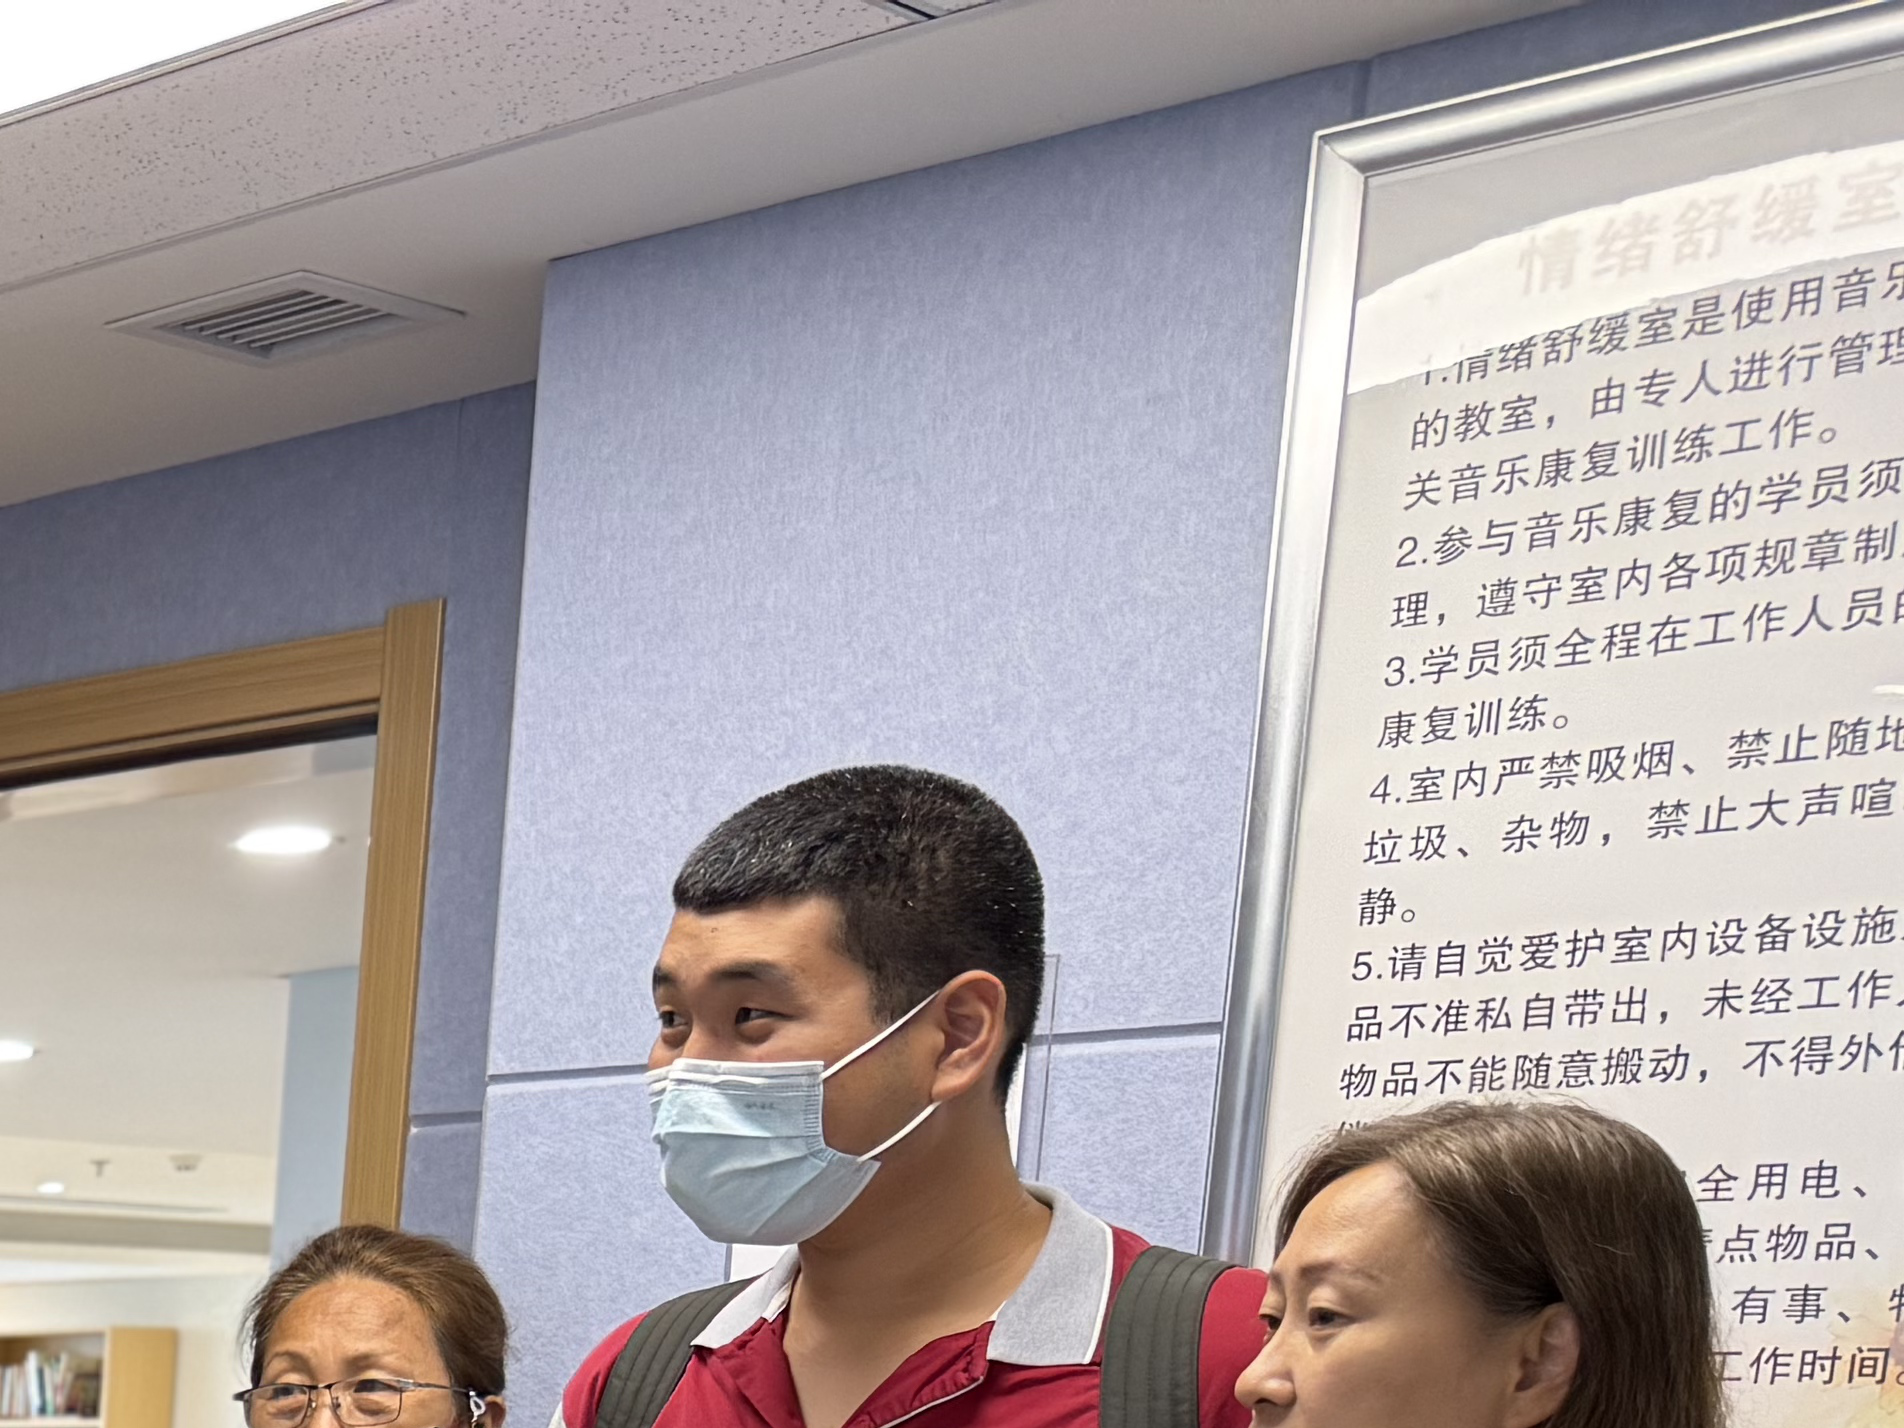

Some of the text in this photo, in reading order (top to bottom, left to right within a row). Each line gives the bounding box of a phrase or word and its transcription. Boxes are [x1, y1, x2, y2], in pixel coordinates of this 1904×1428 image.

[1517, 160, 1904, 296] 情绪舒缓室
[1403, 406, 1837, 513] 关音乐康复训练工作。
[1396, 456, 1904, 568] 2.参与音乐康复的学员须
[1391, 521, 1904, 630] 理，遵守室内各项规章制
[1377, 692, 1571, 751] 康复训练。
[1363, 777, 1904, 868] 垃圾、杂物，禁止大声喧
[1352, 905, 1904, 983] 5.请自觉爱护室内设备设施
[1358, 886, 1419, 926] 静。
[1346, 969, 1904, 1043] 品不准私自带出，未经工作
[1680, 1159, 1867, 1202] 全用电、
[1700, 1223, 1880, 1264] 点物品、
